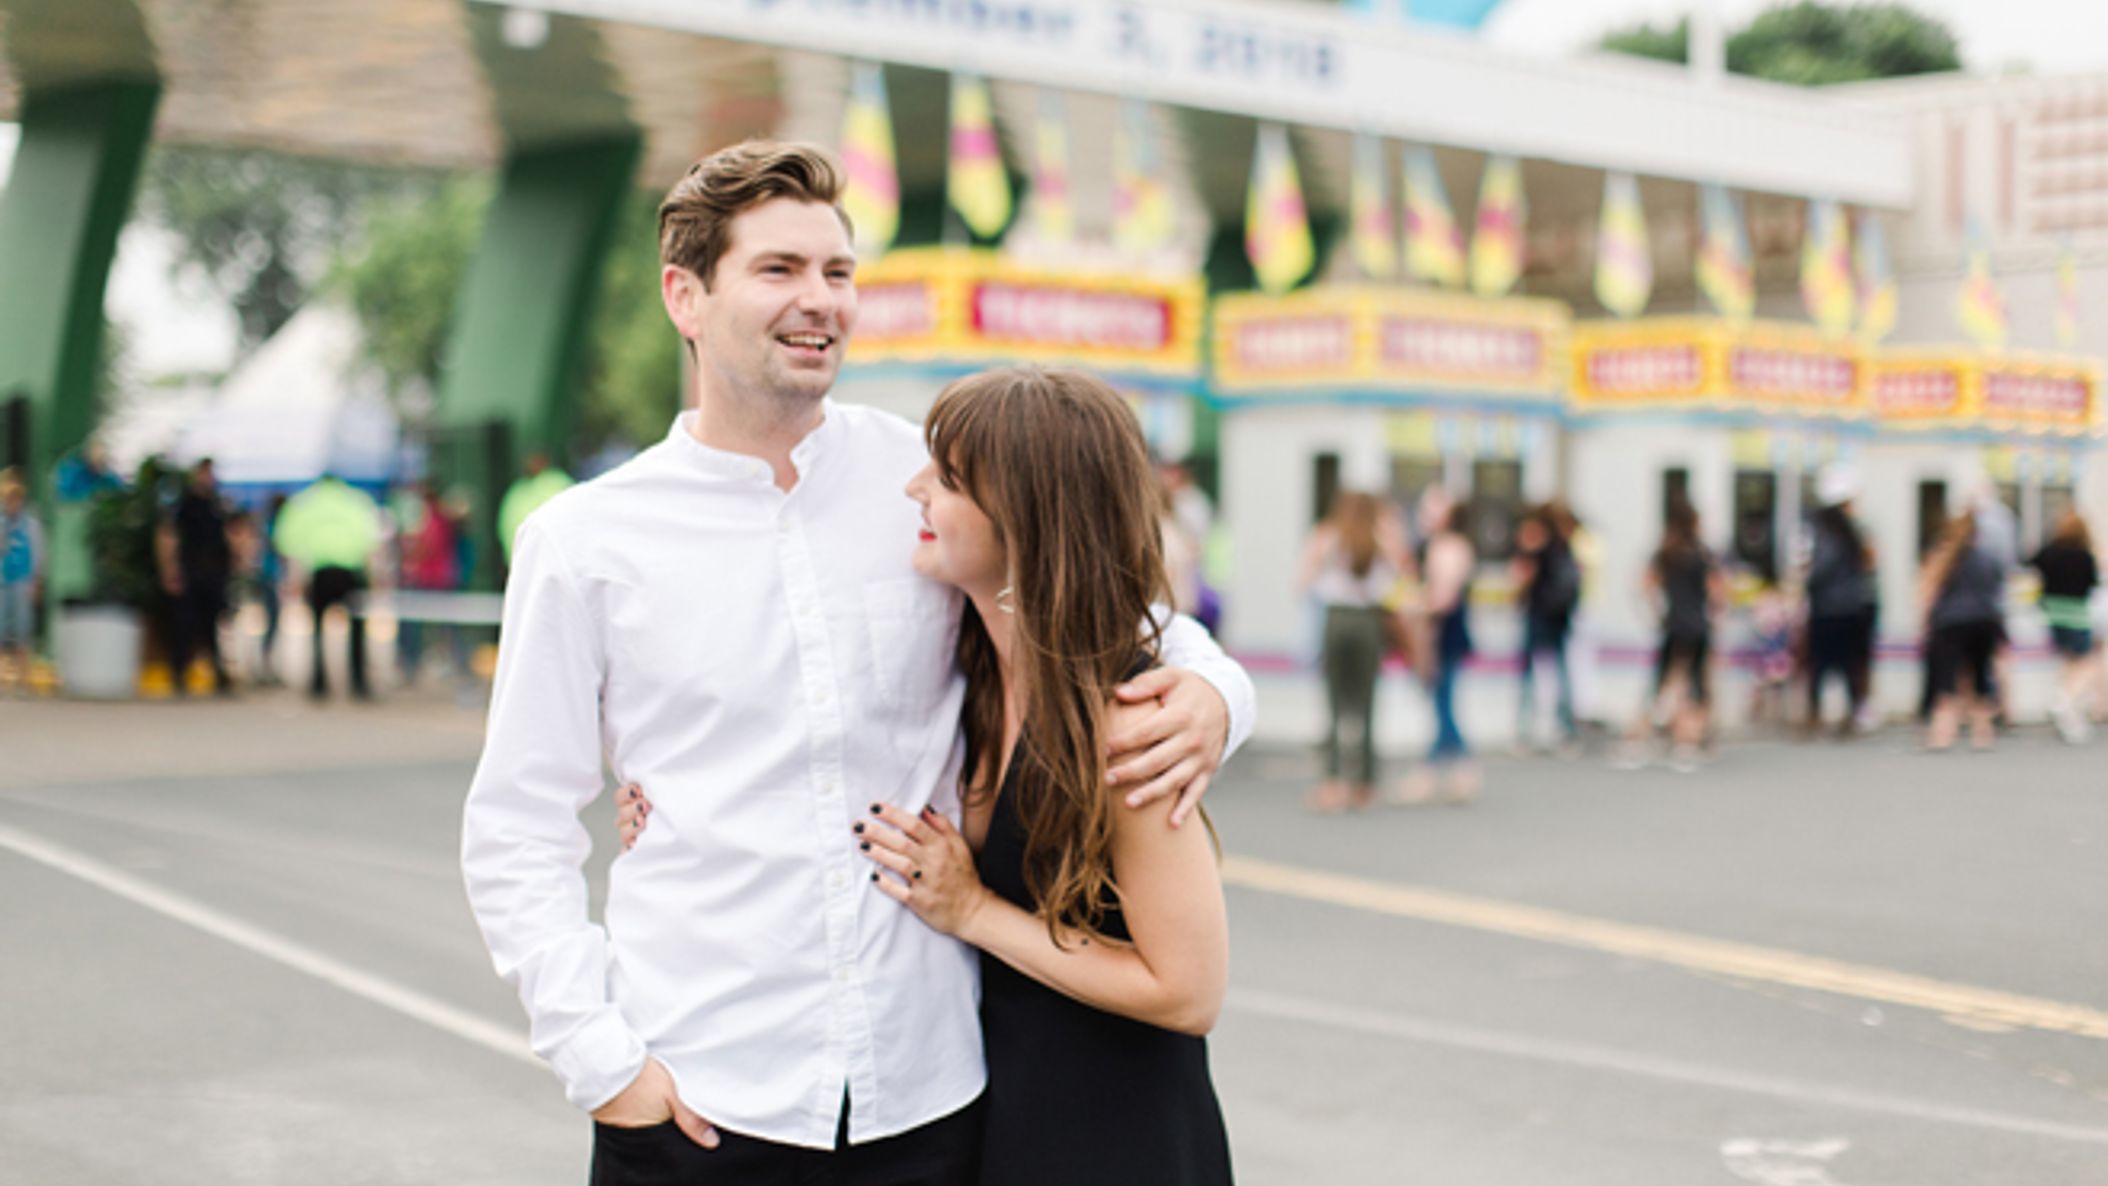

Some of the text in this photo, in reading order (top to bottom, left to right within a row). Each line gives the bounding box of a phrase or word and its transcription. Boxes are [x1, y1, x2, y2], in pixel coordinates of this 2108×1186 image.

[1110, 6, 1166, 64] 3,
[1194, 22, 1340, 80] 2018
[976, 284, 1166, 347] TICKETS
